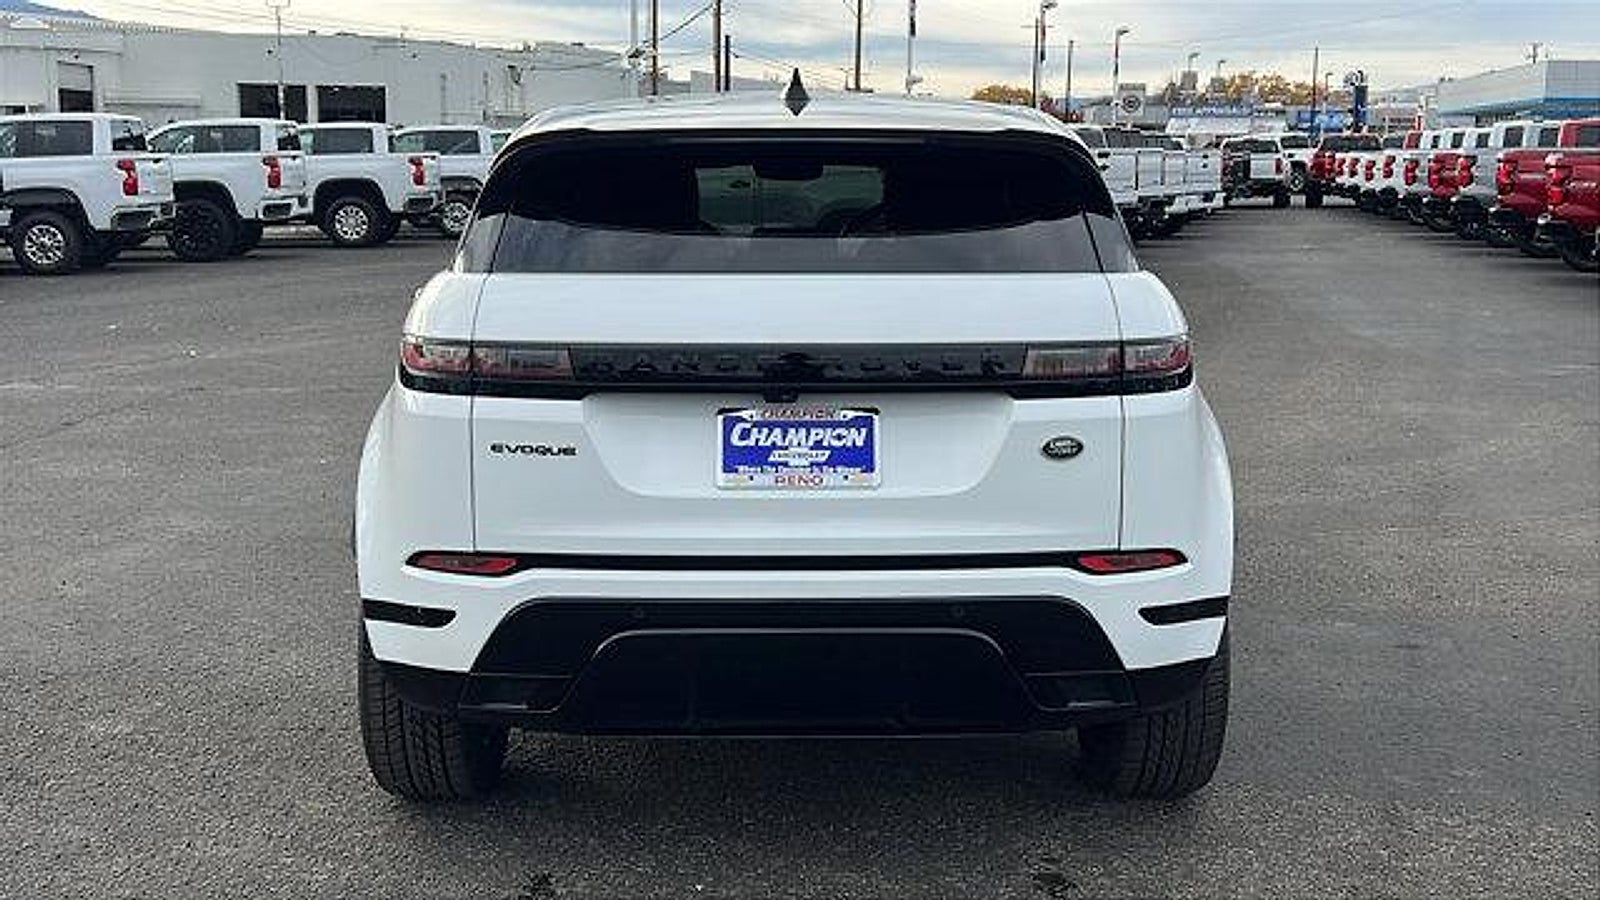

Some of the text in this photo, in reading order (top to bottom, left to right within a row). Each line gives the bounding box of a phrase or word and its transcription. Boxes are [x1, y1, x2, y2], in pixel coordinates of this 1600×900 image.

[730, 422, 867, 447] CHAMPION
[490, 443, 577, 456] EVOQUE
[775, 474, 824, 486] RENO
